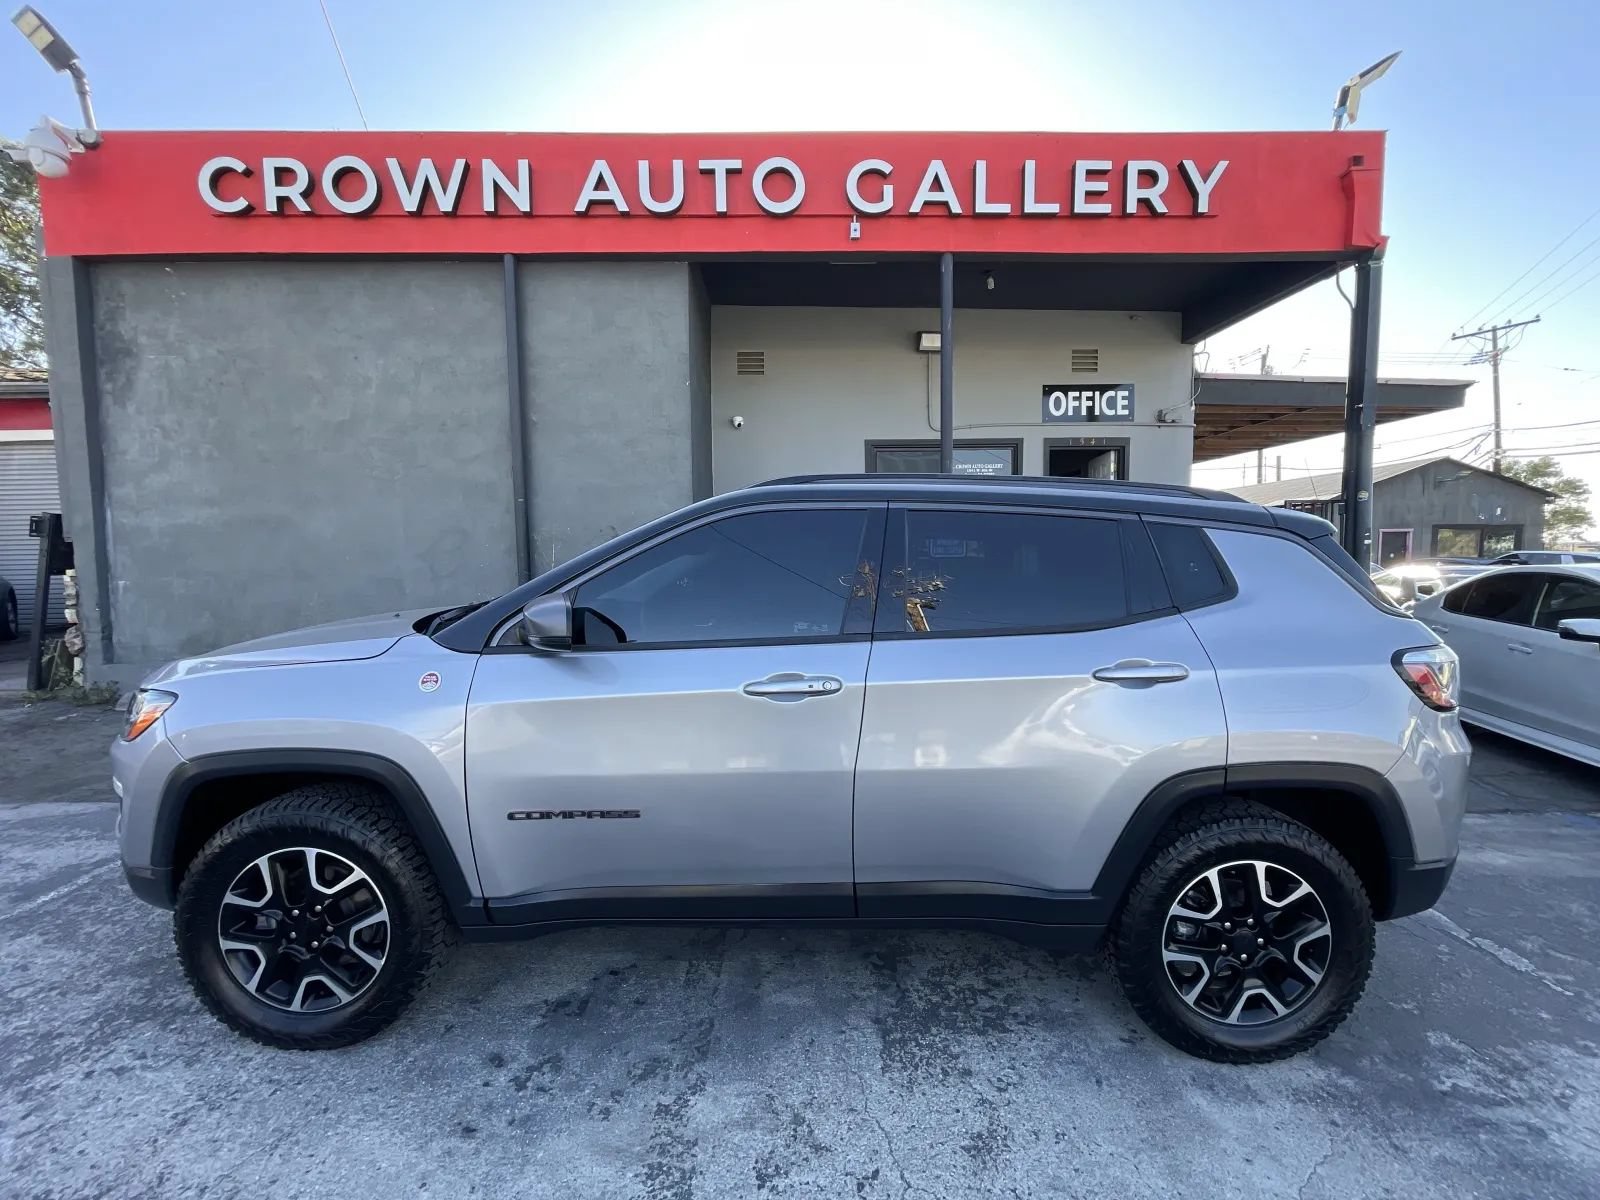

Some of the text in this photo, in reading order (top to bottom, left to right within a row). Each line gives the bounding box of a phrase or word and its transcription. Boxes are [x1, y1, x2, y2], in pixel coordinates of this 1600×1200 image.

[198, 155, 1230, 217] CROWN AUTO GALLERY
[1048, 390, 1130, 416] OFFICE
[507, 810, 641, 821] COMPASS
